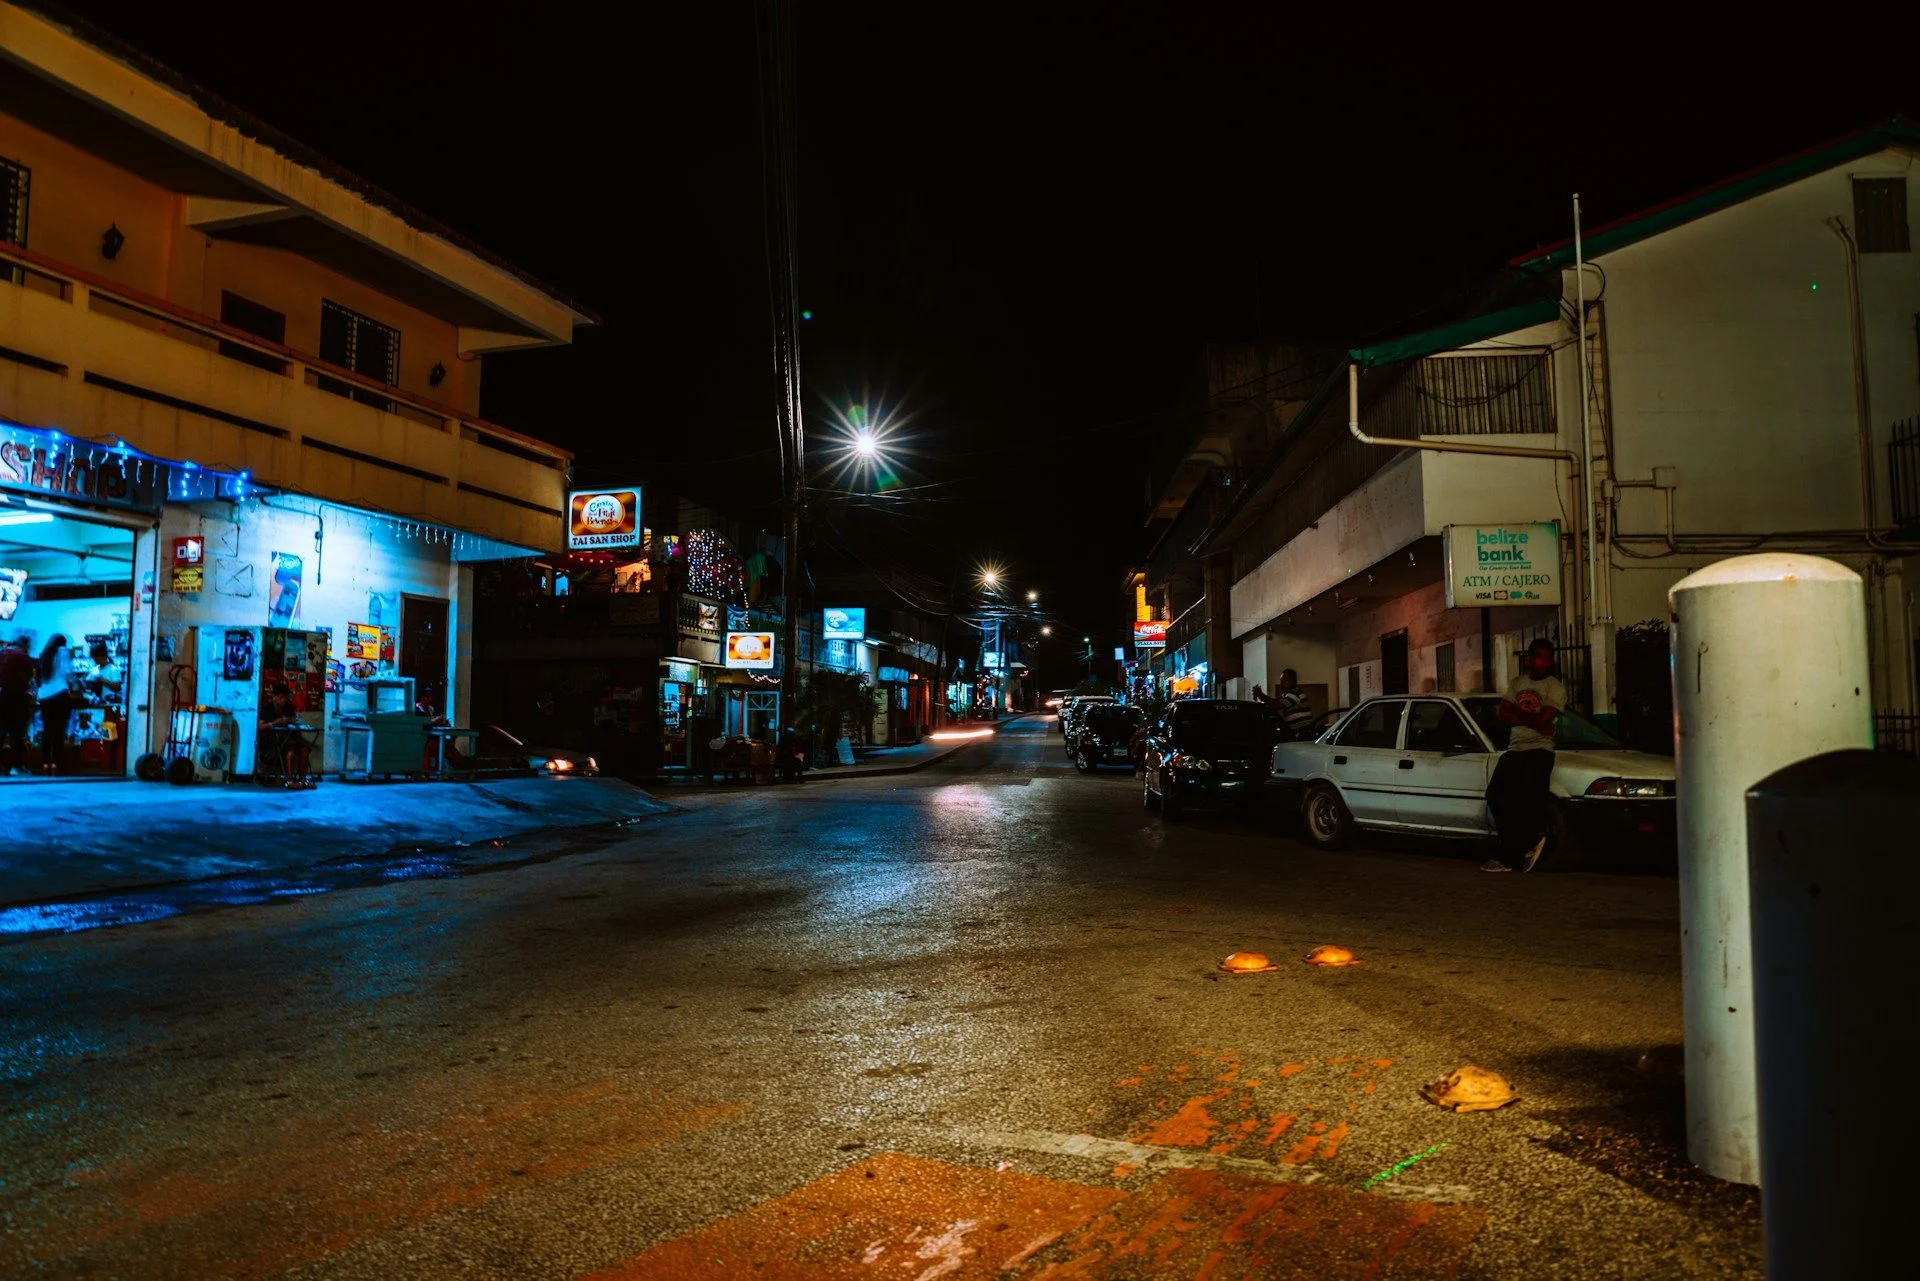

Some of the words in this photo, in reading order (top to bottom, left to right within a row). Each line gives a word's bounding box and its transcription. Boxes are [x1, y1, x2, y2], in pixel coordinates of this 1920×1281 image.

[590, 536, 609, 544] SAN
[611, 535, 635, 543] SHOP
[1476, 528, 1529, 545] belize
[1477, 546, 1524, 561] bank
[1463, 576, 1491, 587] ATM
[1502, 574, 1551, 588] CAJERO
